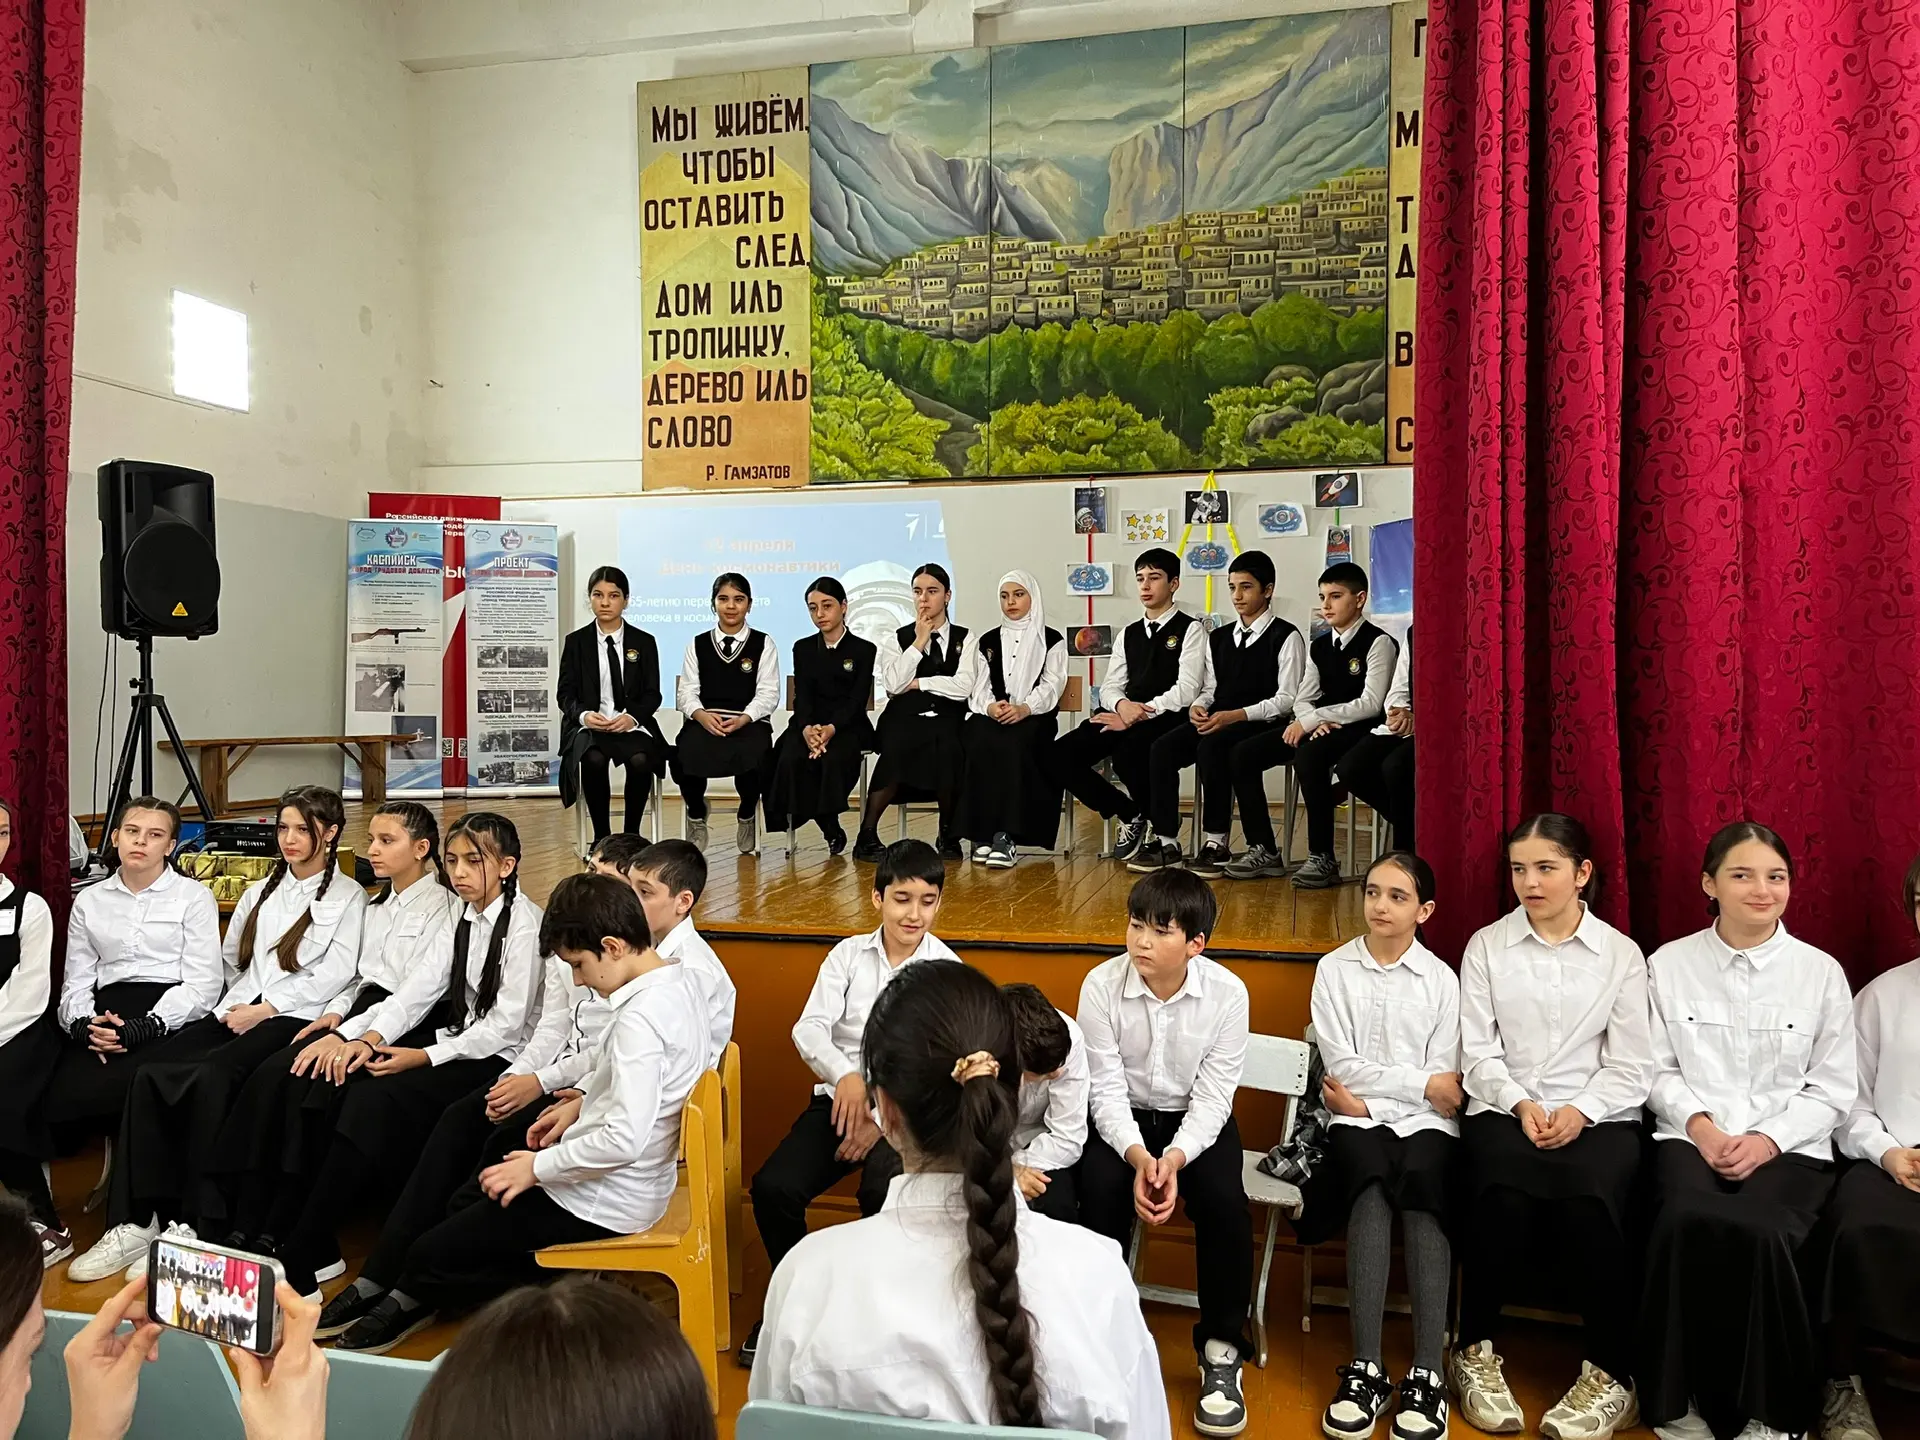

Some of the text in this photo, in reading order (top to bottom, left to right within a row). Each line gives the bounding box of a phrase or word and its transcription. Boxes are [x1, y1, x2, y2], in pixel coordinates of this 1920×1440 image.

[652, 93, 810, 143] МЫ ЖИВЁМ,
[682, 146, 775, 185] ЧТОБЫ
[644, 190, 784, 231] ОСТАВИТЬ
[655, 280, 783, 318] ДОМ ИЛЬ
[648, 324, 790, 361] ТРОПИНКУ,
[647, 369, 808, 406] ДЕРЕВО ИЛЬ
[647, 415, 732, 448] СЛОВО
[706, 465, 719, 481] Р.
[494, 556, 530, 569] ПРОЕКТ
[730, 538, 796, 555] апреля
[713, 560, 840, 574] космонавтики
